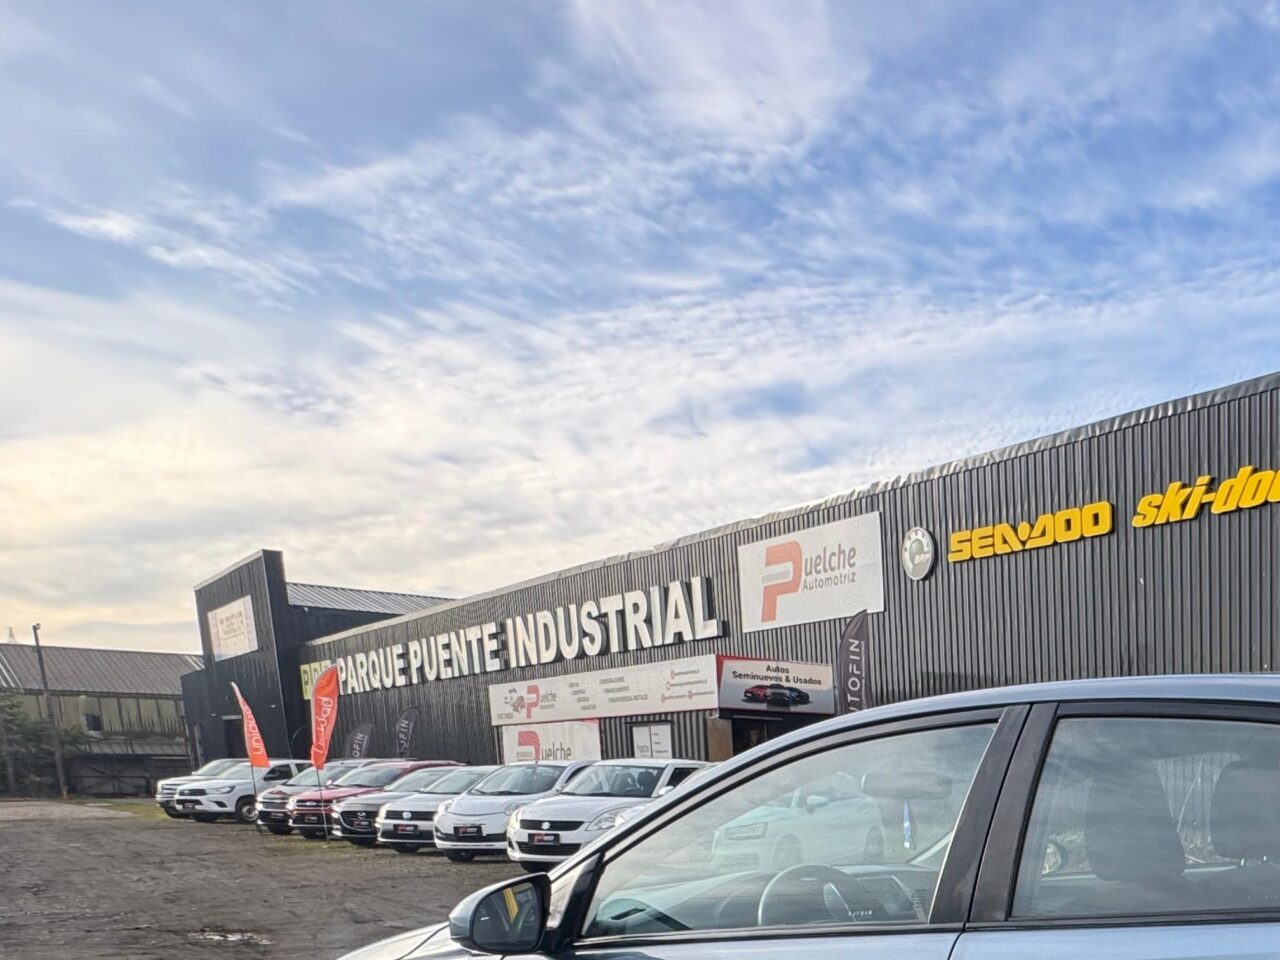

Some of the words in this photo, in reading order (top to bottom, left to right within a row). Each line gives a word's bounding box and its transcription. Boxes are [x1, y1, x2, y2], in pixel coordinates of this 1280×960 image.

[803, 571, 857, 592] Automotriz
[336, 644, 406, 696] PARQUE
[408, 622, 500, 685] PUENTE
[505, 576, 721, 669] INDUSTRIAL
[732, 670, 783, 683] Seminuevos
[793, 675, 822, 686] Usados
[765, 664, 790, 674] Autos
